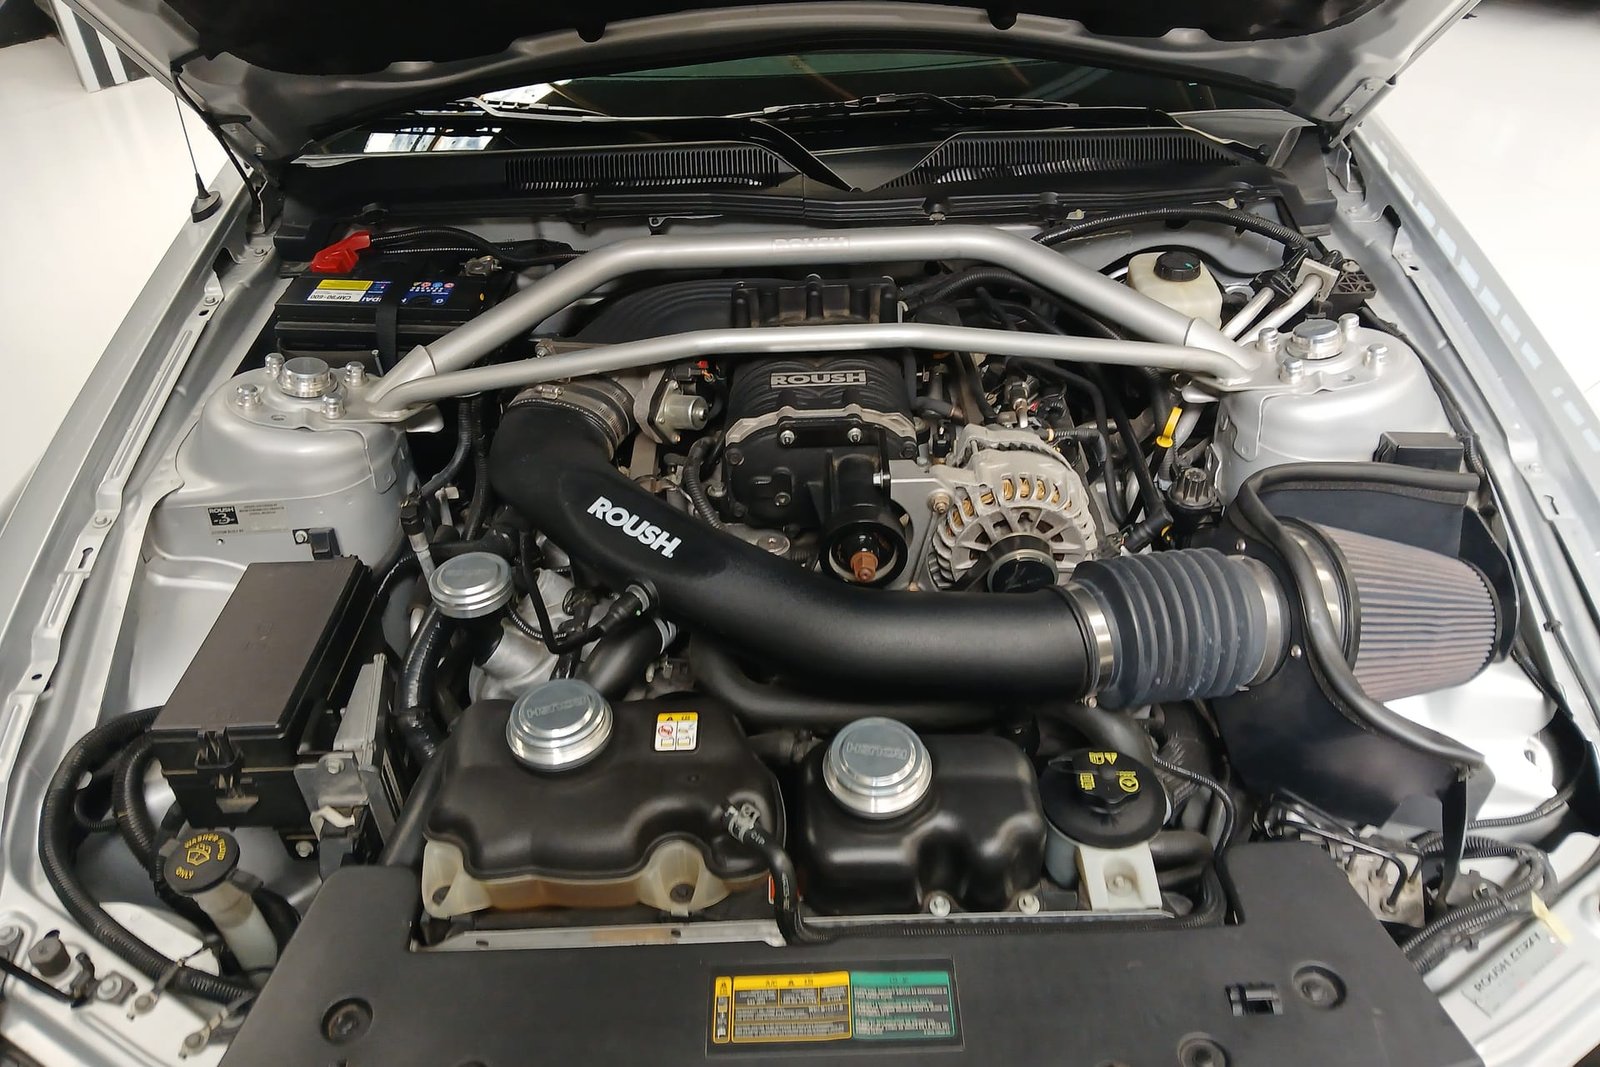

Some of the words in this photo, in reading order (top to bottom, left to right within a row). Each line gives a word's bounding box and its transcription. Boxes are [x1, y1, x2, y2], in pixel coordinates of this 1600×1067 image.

[772, 373, 866, 385] ROUSH
[208, 506, 235, 514] ROUSH
[586, 495, 682, 559] ROUSH
[175, 866, 194, 880] ONLY
